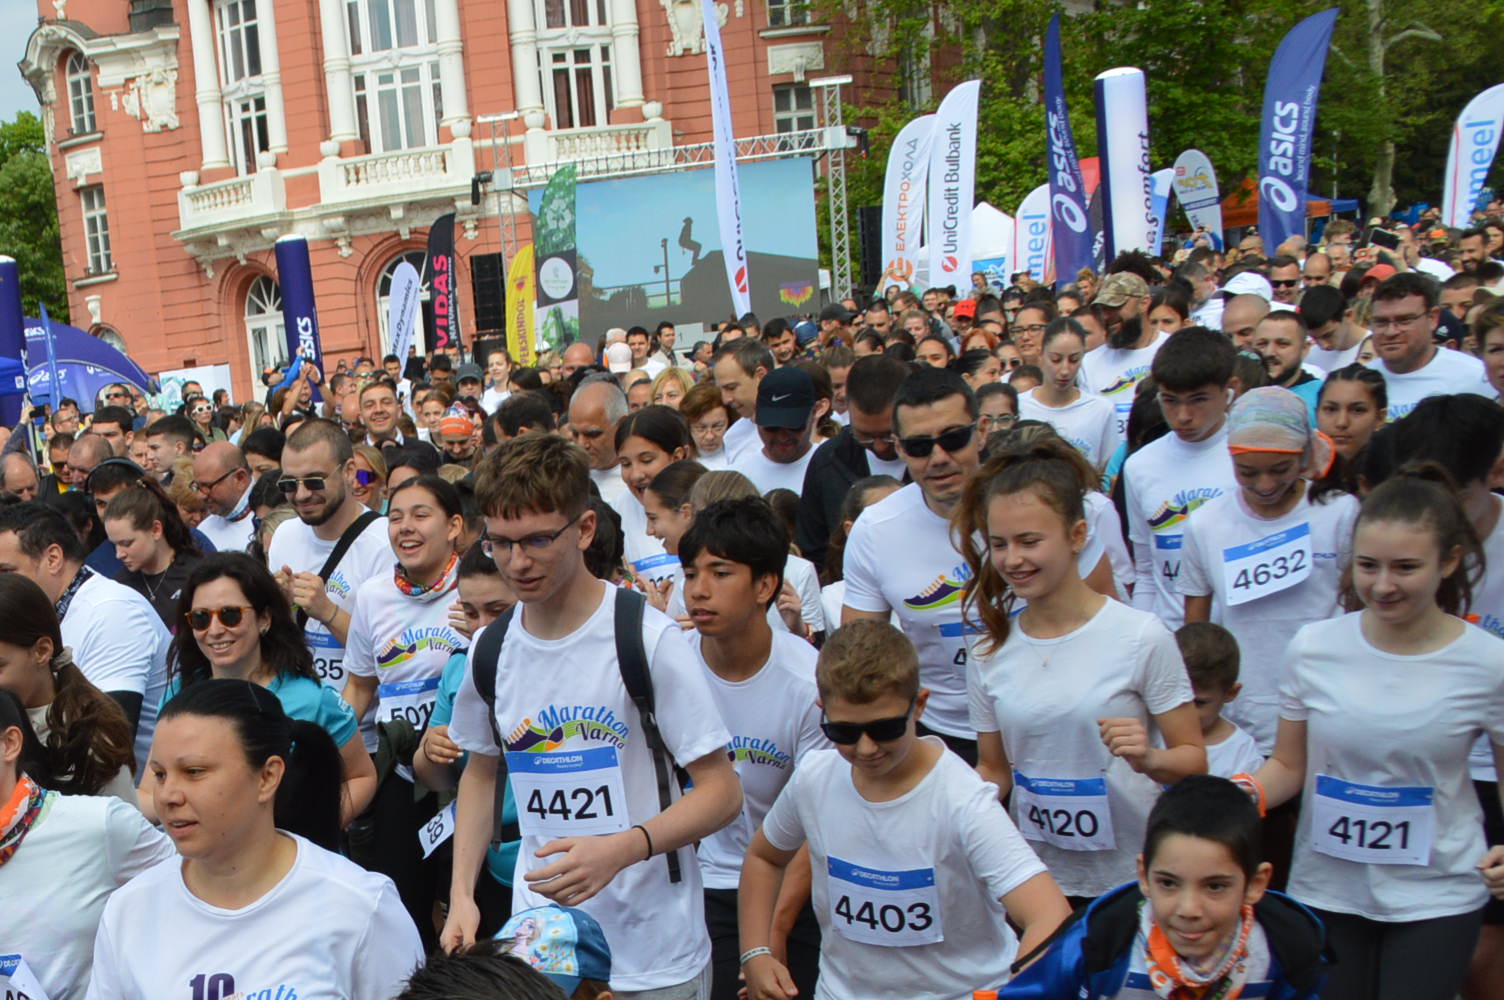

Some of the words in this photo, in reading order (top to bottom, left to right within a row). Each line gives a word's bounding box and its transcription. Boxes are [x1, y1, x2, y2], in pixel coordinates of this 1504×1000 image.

[944, 122, 962, 183] Bulbank
[942, 183, 960, 253] UniCredit
[1233, 549, 1307, 589] 4632
[426, 637, 454, 655] Varn
[314, 658, 344, 681] 35
[538, 704, 629, 740] Marathon
[576, 721, 625, 750] Varna
[527, 784, 614, 821] 4421
[1028, 804, 1098, 838] 4120
[1329, 815, 1412, 850] 4121
[835, 894, 933, 933] 4403
